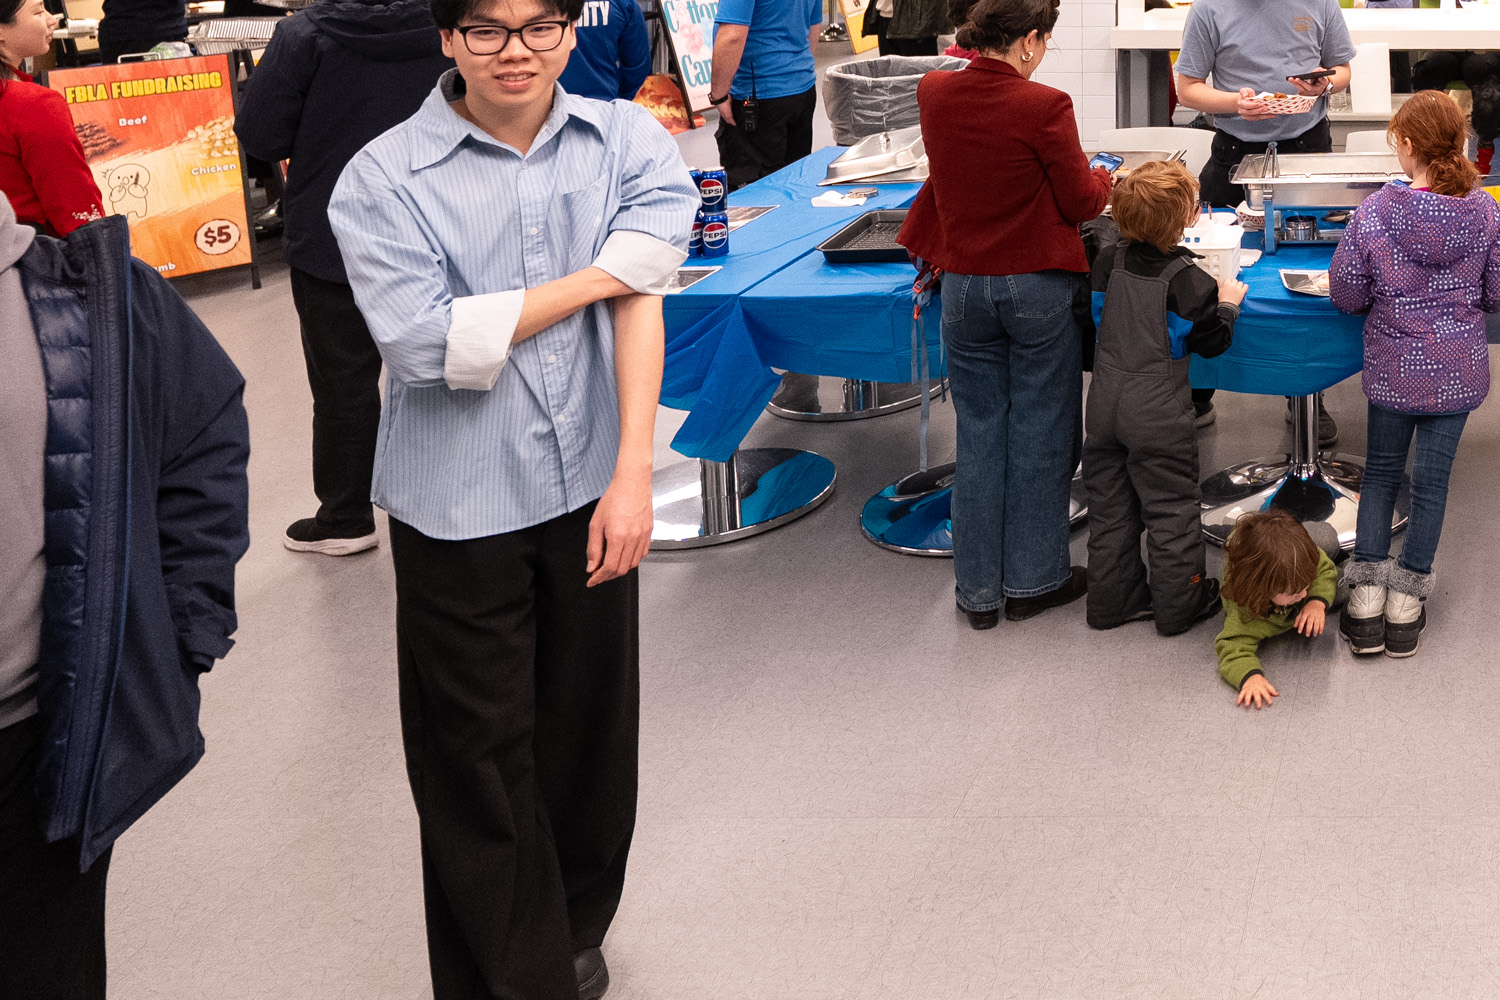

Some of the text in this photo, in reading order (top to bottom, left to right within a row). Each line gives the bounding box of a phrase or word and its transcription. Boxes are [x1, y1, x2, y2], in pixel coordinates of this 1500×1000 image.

[574, 0, 610, 28] ITY
[682, 54, 712, 88] Can
[64, 71, 223, 105] FBLA FUNDRAISING
[118, 115, 148, 127] Beef
[191, 163, 237, 176] Chicken
[700, 188, 723, 196] PEPSI
[203, 224, 232, 248] $5
[703, 230, 727, 239] PEPSI
[152, 261, 176, 273] mb
